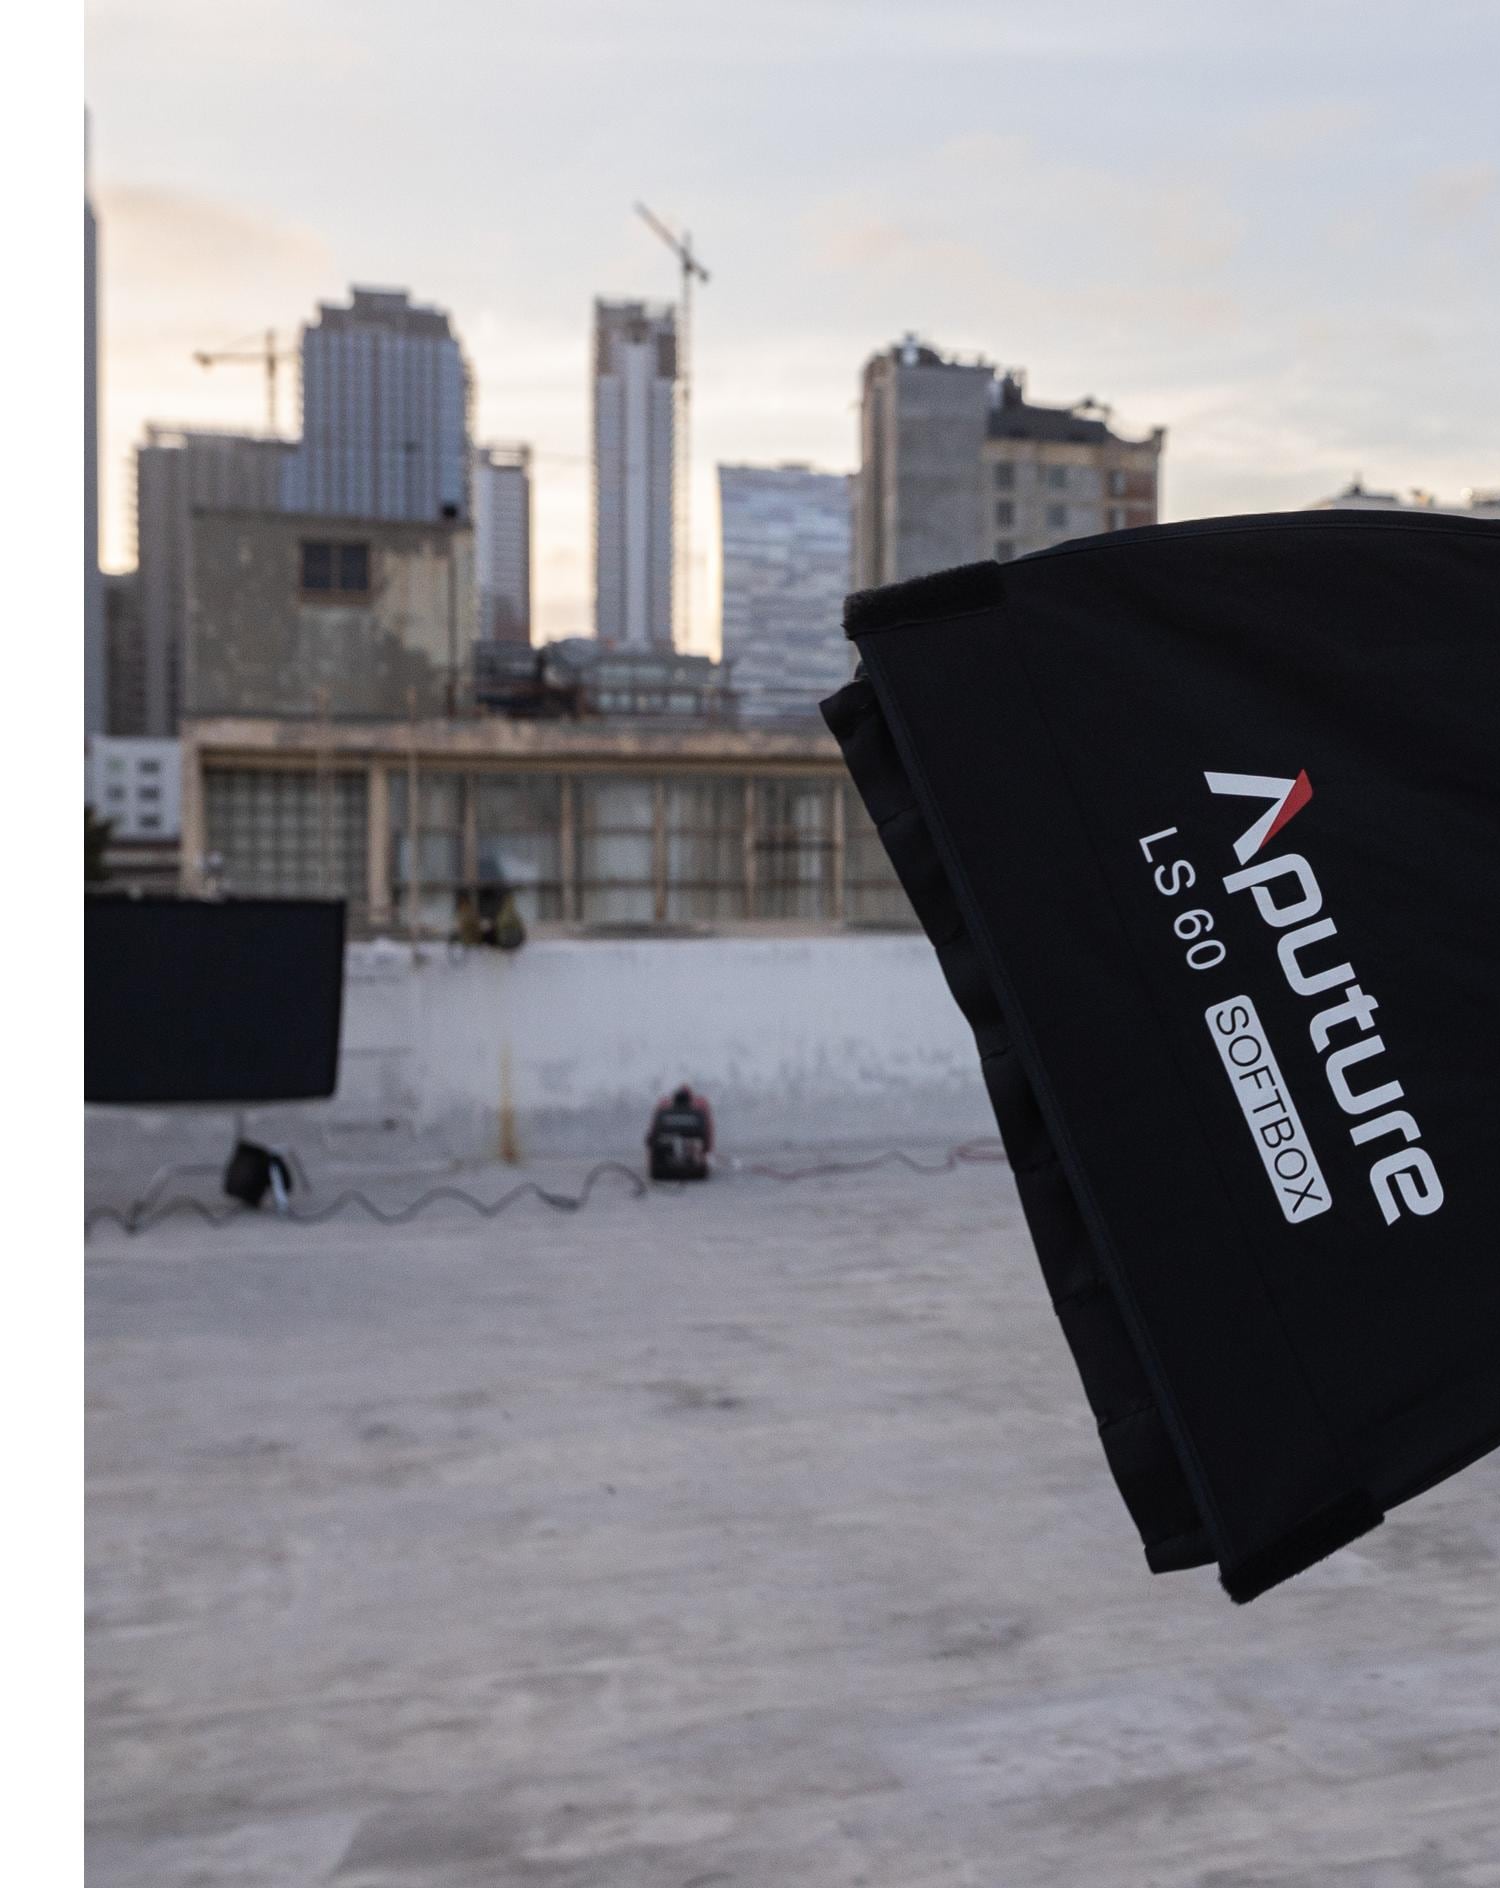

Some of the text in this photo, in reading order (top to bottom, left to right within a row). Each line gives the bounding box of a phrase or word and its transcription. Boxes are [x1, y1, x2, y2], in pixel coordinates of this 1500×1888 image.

[1138, 826, 1324, 1214] LS 60 SOFTBOX
[1204, 768, 1445, 1227] Aputure
